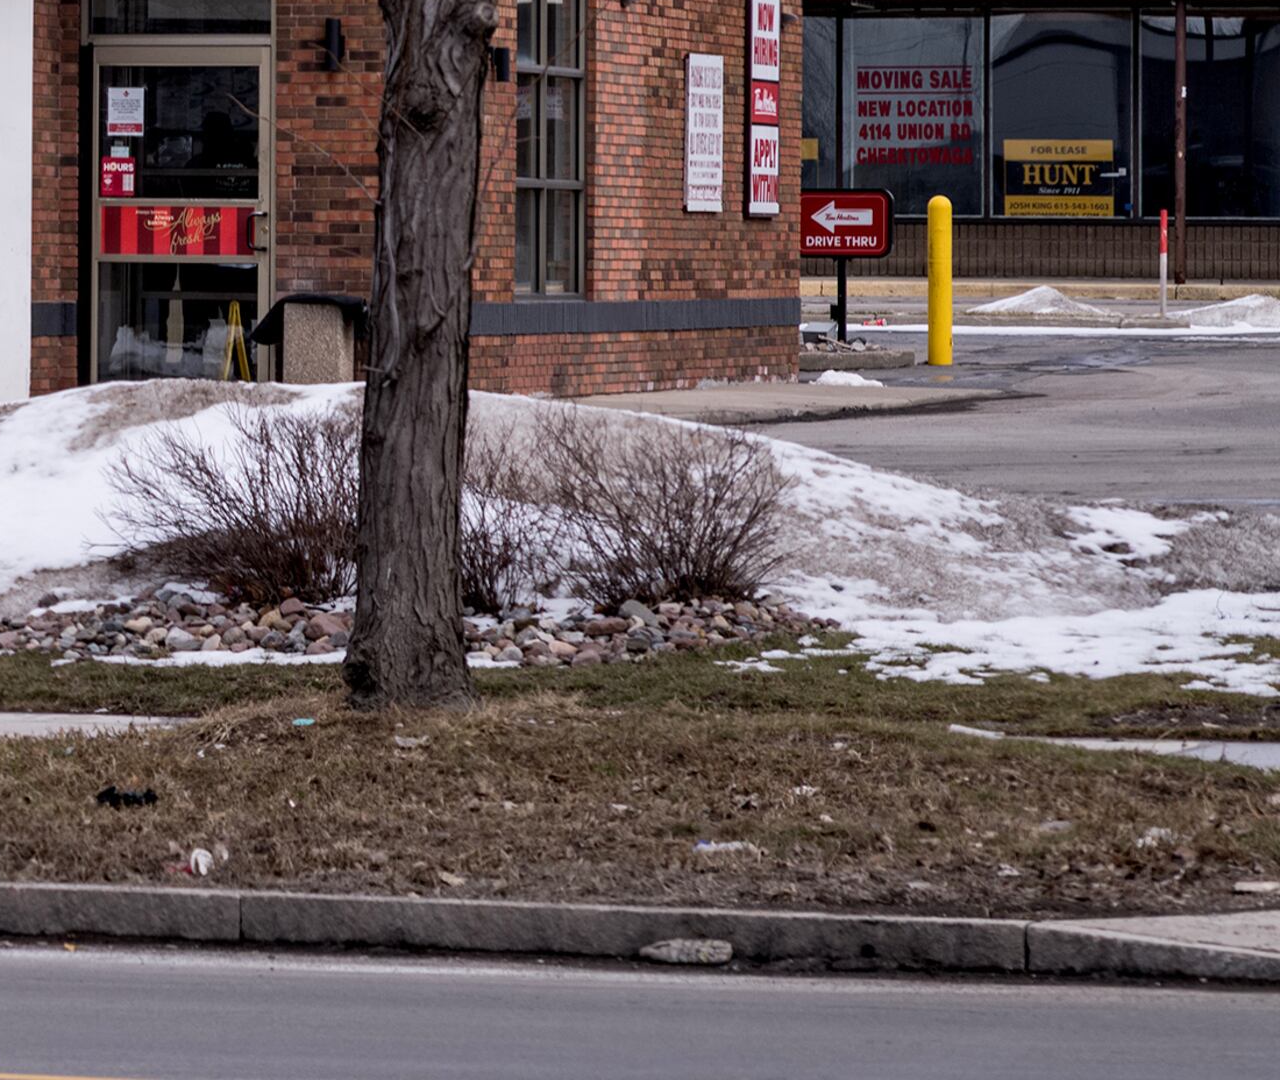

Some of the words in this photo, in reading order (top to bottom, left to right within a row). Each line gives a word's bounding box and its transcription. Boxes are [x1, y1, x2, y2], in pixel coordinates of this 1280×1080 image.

[757, 3, 775, 32] NOW
[753, 37, 777, 67] HIRING
[857, 70, 923, 89] MOVING
[930, 70, 972, 89] SALE
[858, 100, 891, 117] NEW
[897, 100, 973, 117] LOCATION
[859, 123, 891, 140] 4114
[897, 123, 944, 140] UNION
[951, 123, 971, 140] RD
[753, 139, 777, 169] APPLY
[857, 146, 973, 165] CHEEKTOWAGA
[1031, 146, 1052, 154] FOR
[1055, 146, 1087, 154] LEASE
[103, 162, 134, 171] HOURS
[1023, 164, 1095, 185] HUNT
[752, 175, 778, 203] WITHIN
[162, 205, 222, 238] Always
[169, 231, 202, 256] fresh
[806, 236, 841, 247] DRIVE
[844, 236, 877, 247] THRU
